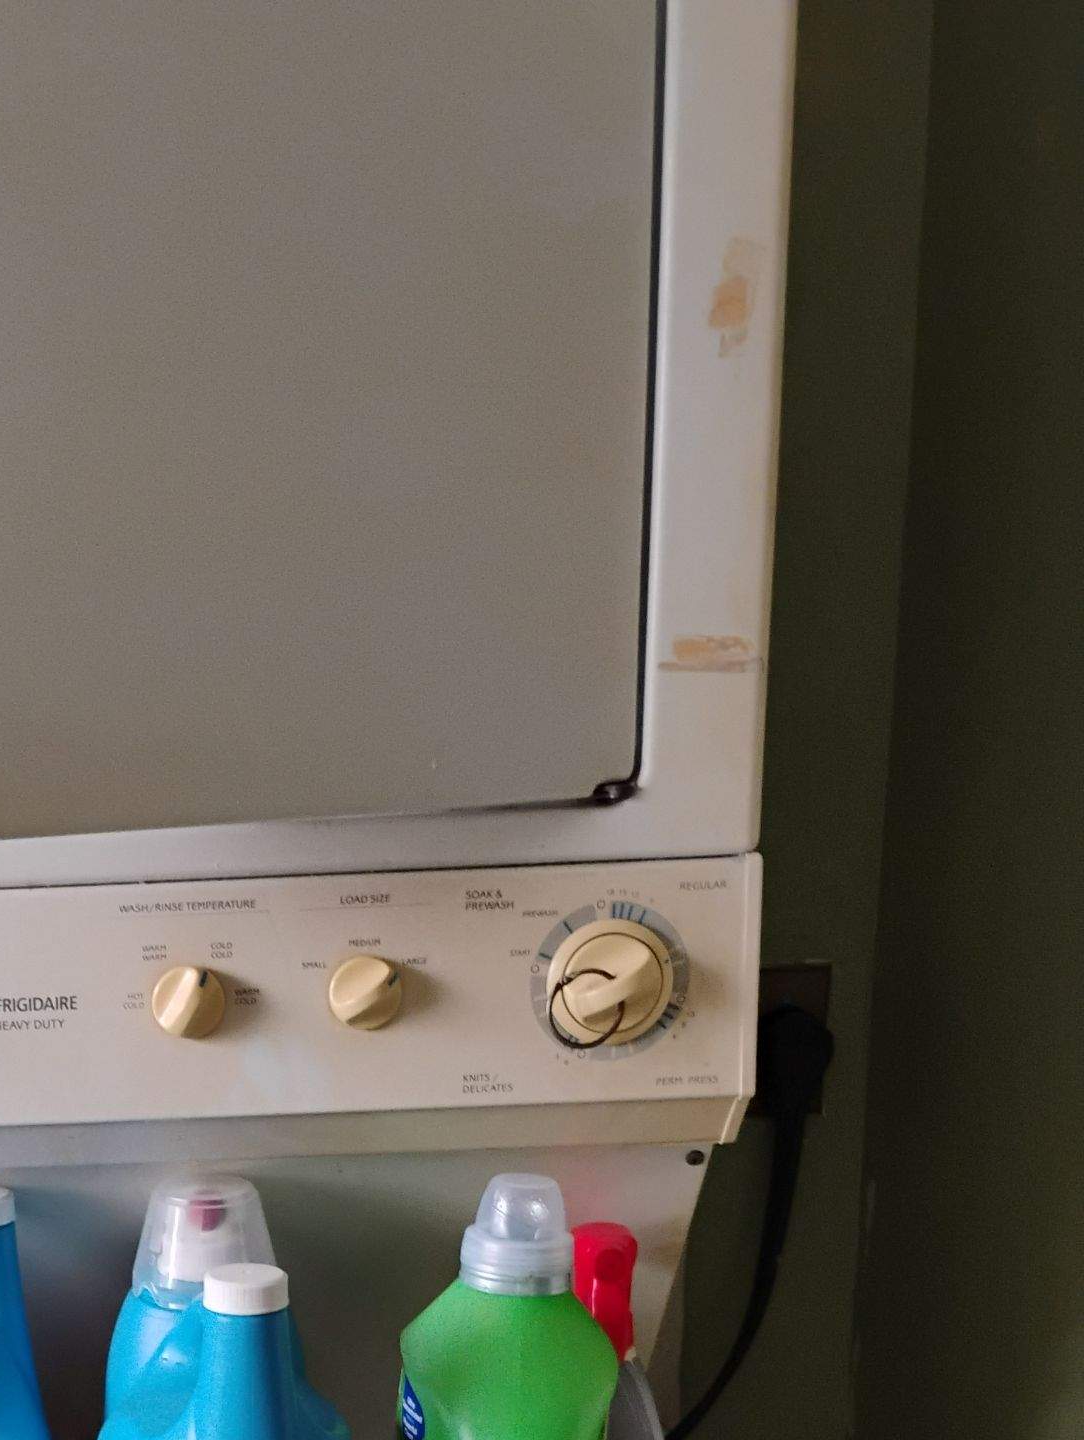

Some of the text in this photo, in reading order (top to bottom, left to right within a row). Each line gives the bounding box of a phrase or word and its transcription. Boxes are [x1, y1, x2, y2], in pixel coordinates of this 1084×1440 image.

[340, 894, 390, 904] LOAD SIZE
[119, 899, 256, 914] WASH/RINSE TEMPERATURE
[465, 900, 515, 911] PREWASH
[210, 942, 233, 950] COLD
[348, 939, 381, 947] MEDIUM
[210, 951, 233, 959] COLD
[34, 1018, 64, 1030] DUTY
